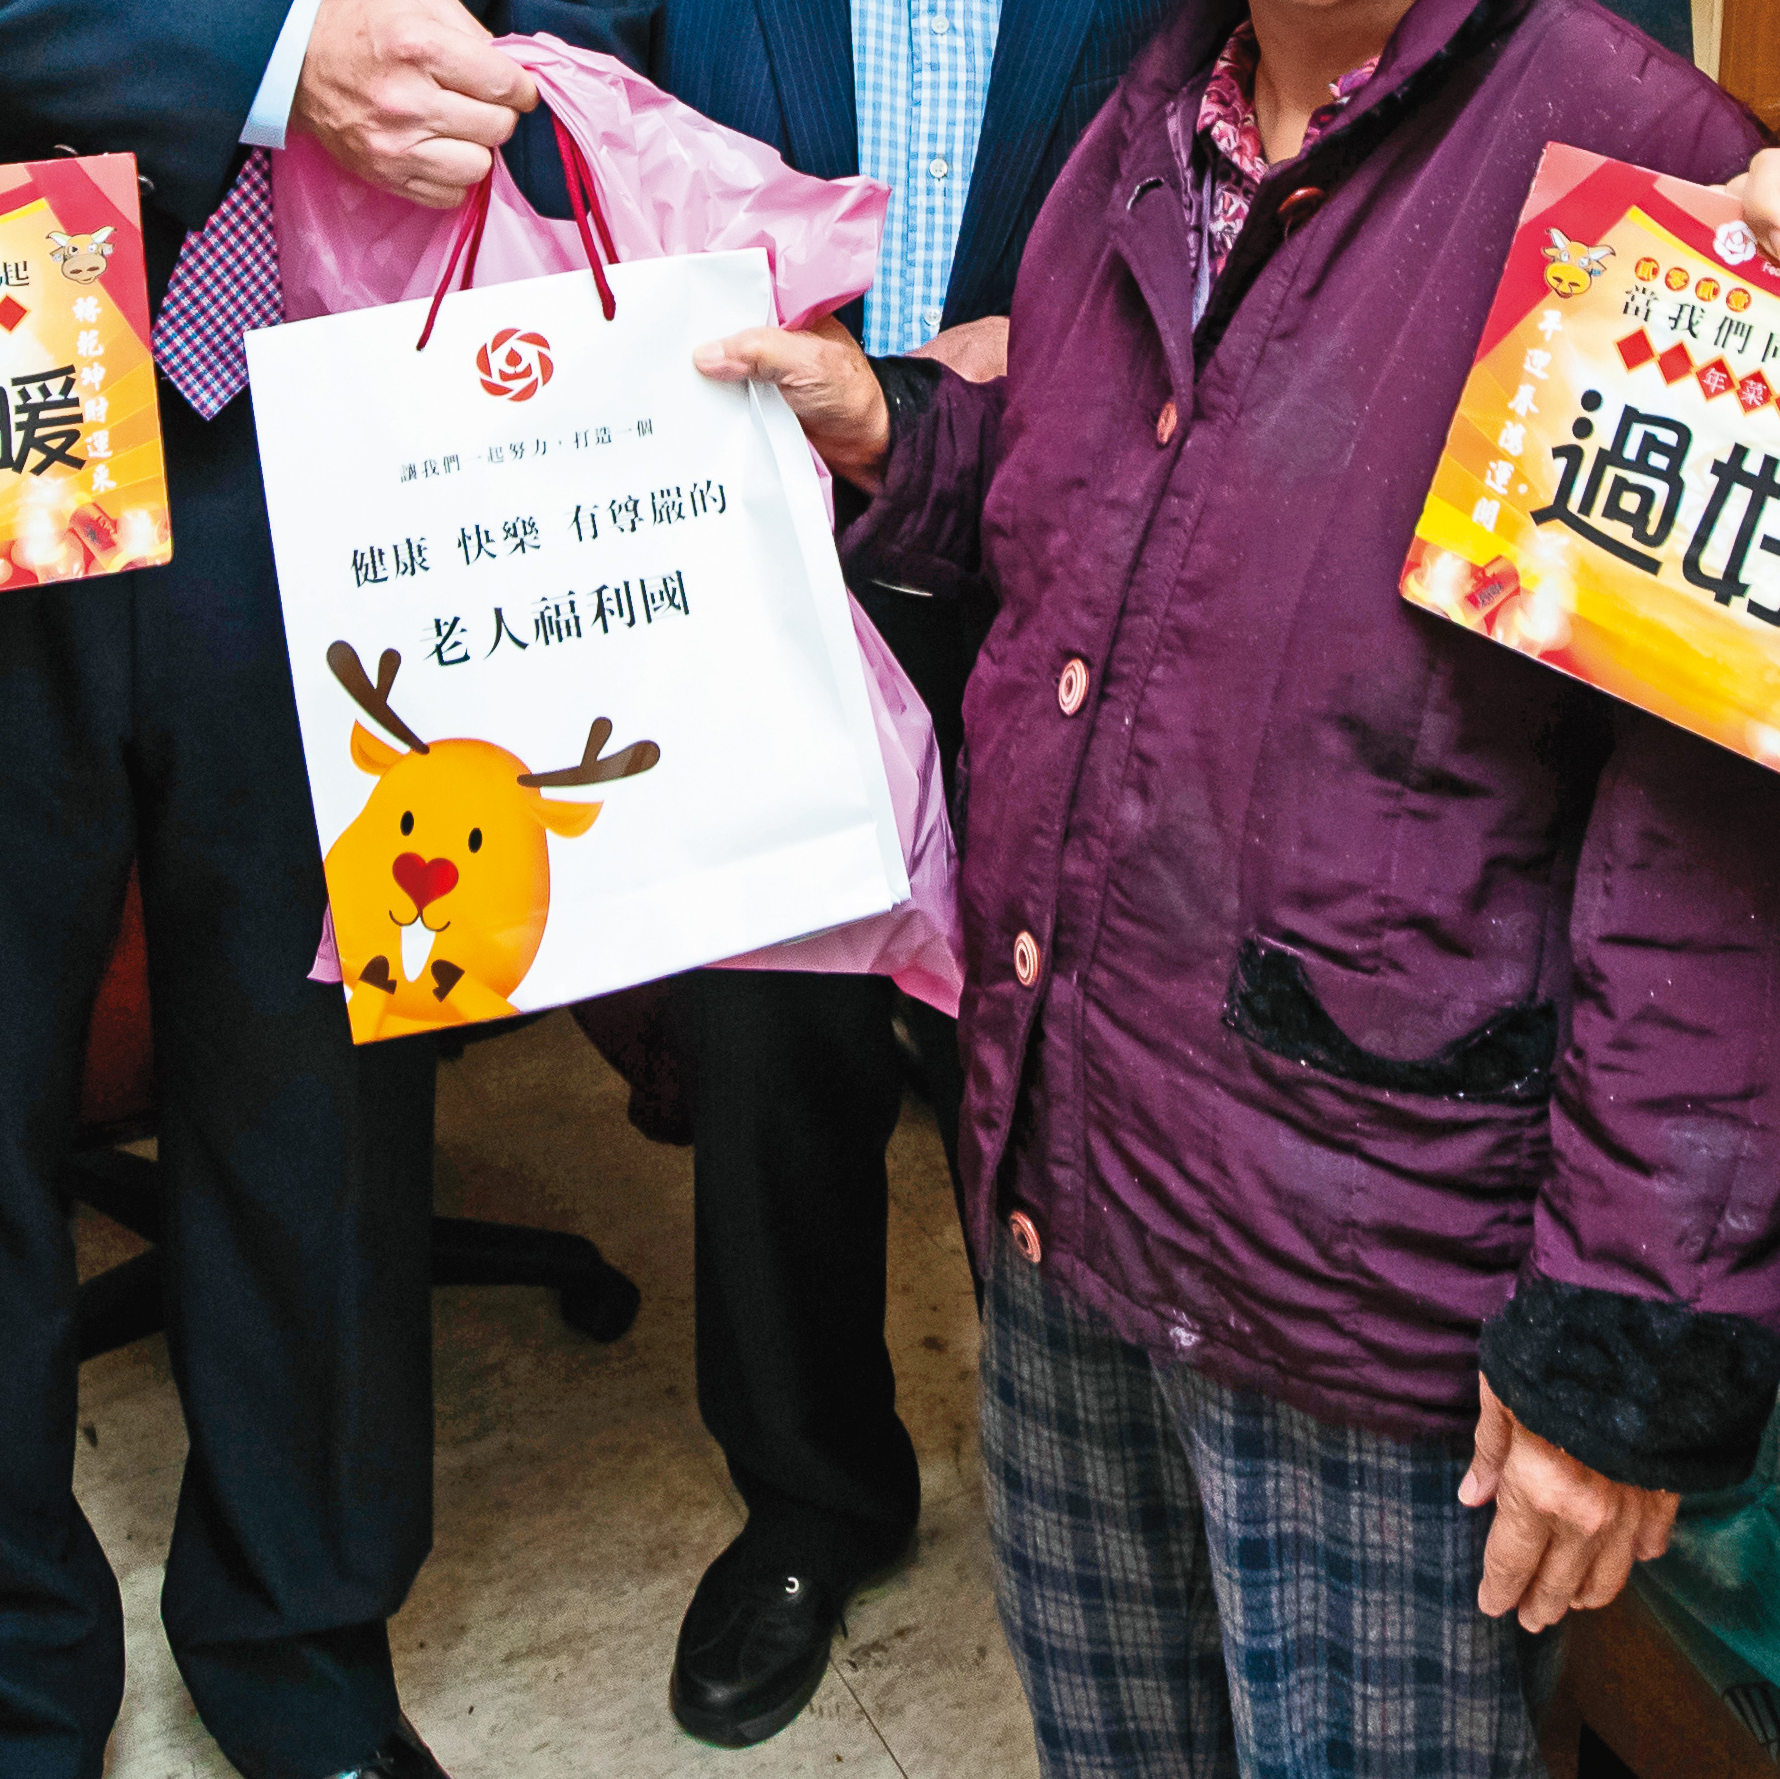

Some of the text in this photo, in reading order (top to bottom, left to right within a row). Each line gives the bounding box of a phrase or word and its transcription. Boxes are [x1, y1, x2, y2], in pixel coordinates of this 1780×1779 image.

[350, 479, 729, 588] 健康 快樂 有尊嚴的
[420, 570, 691, 667] 老人福利國
